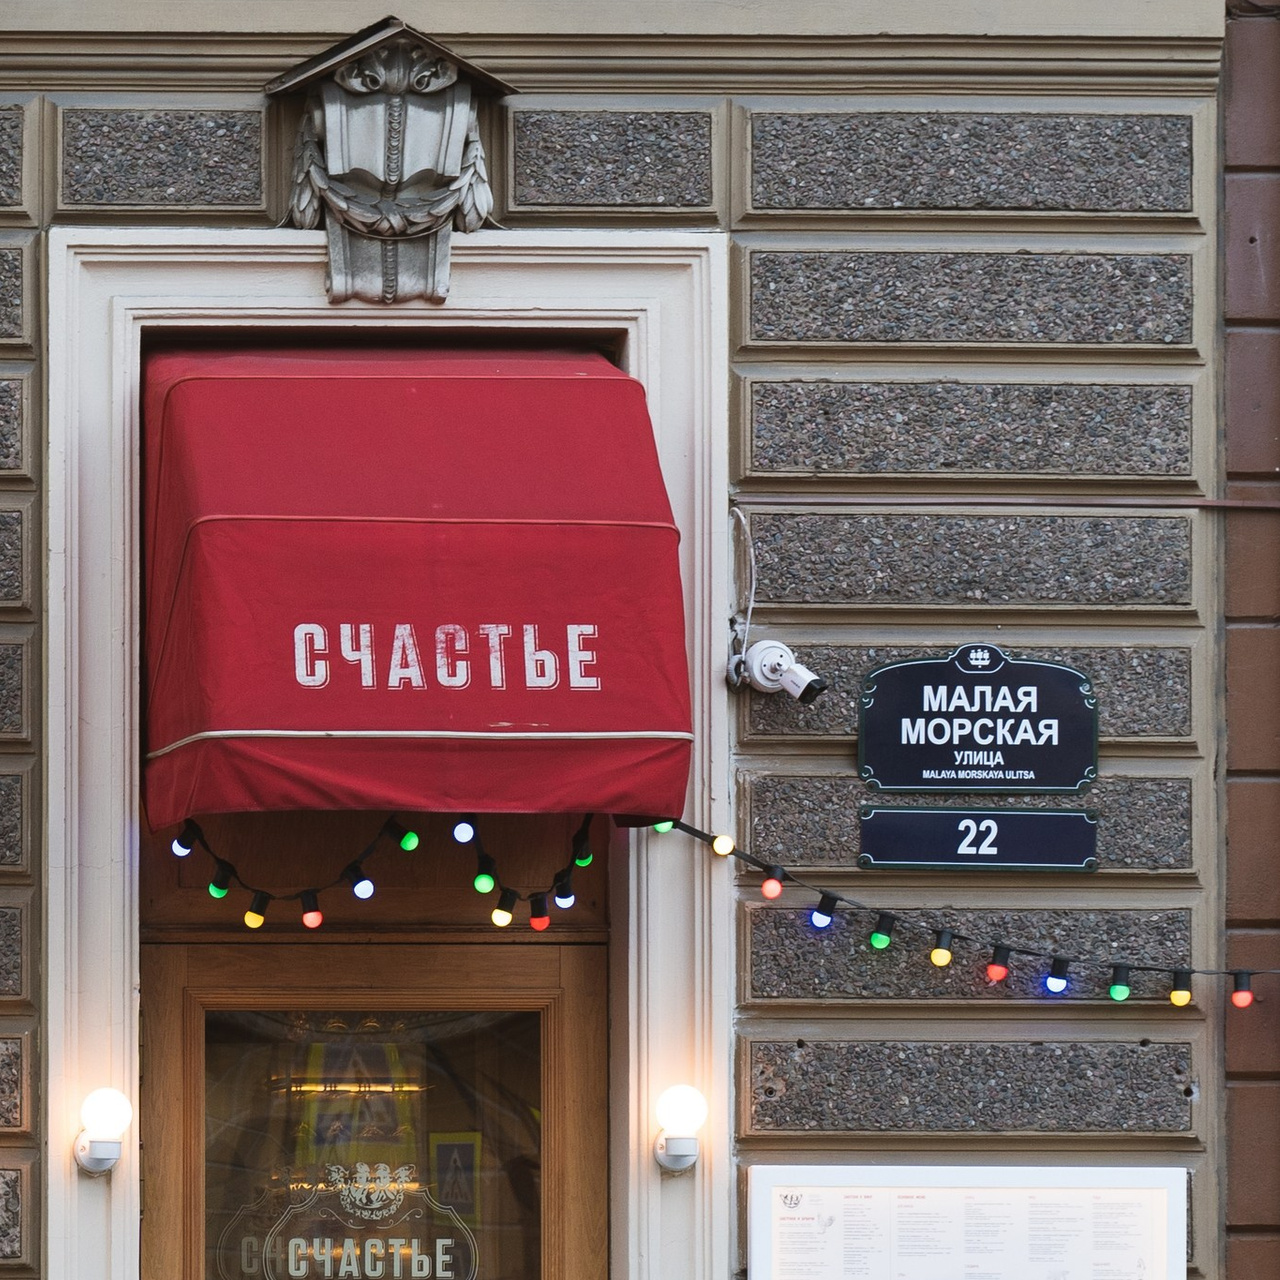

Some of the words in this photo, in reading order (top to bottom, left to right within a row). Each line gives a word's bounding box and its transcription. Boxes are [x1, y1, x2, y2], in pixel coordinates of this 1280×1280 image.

[293, 623, 602, 691] СЧАСТЬЕ
[923, 685, 1038, 713] МАЛАЯ
[901, 718, 1059, 745] МОРСКАЯ
[954, 750, 1005, 767] УЛИЦА
[922, 769, 957, 779] MALAYA
[958, 770, 1005, 779] MORSKAYA
[1005, 770, 1036, 780] ULITSA
[957, 818, 998, 855] 22
[287, 1237, 455, 1280] СЧАСТЬЕ
